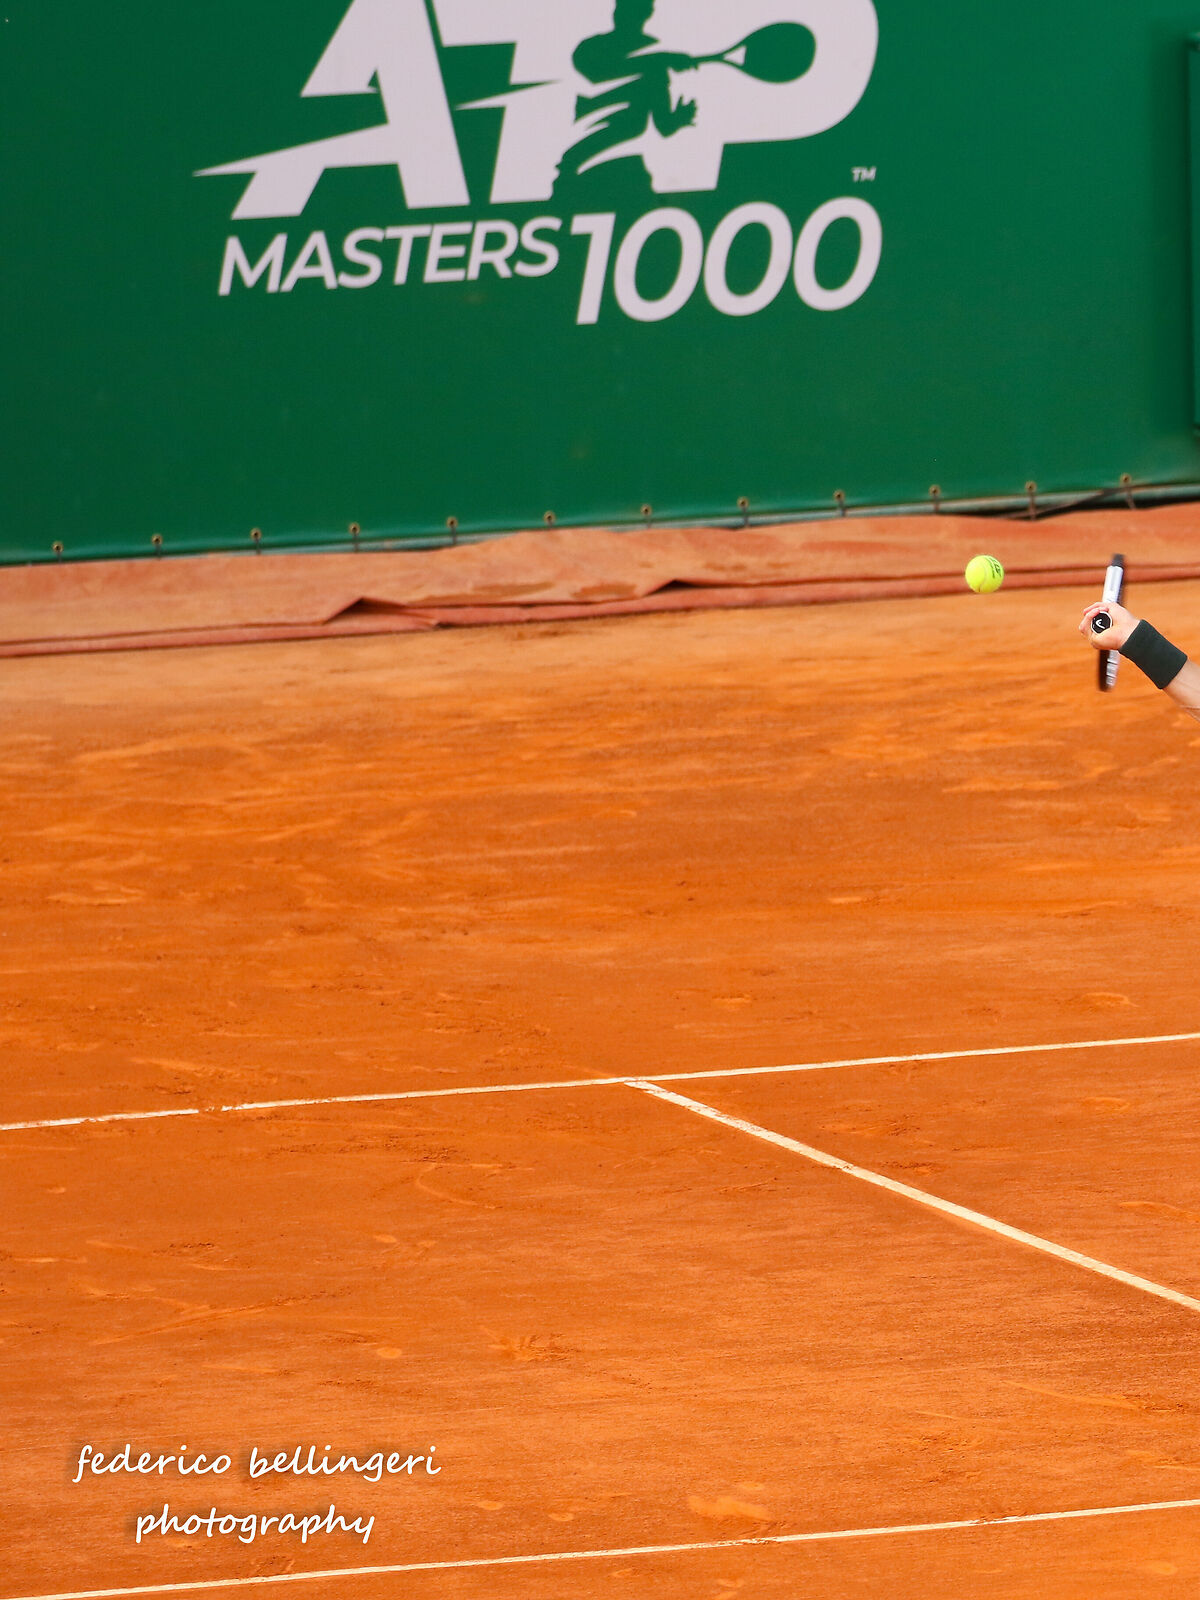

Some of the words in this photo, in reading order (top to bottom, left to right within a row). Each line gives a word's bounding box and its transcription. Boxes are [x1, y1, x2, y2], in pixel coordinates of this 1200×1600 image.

[851, 166, 877, 183] TM
[217, 216, 562, 297] MASTERS
[569, 197, 883, 325] 1000
